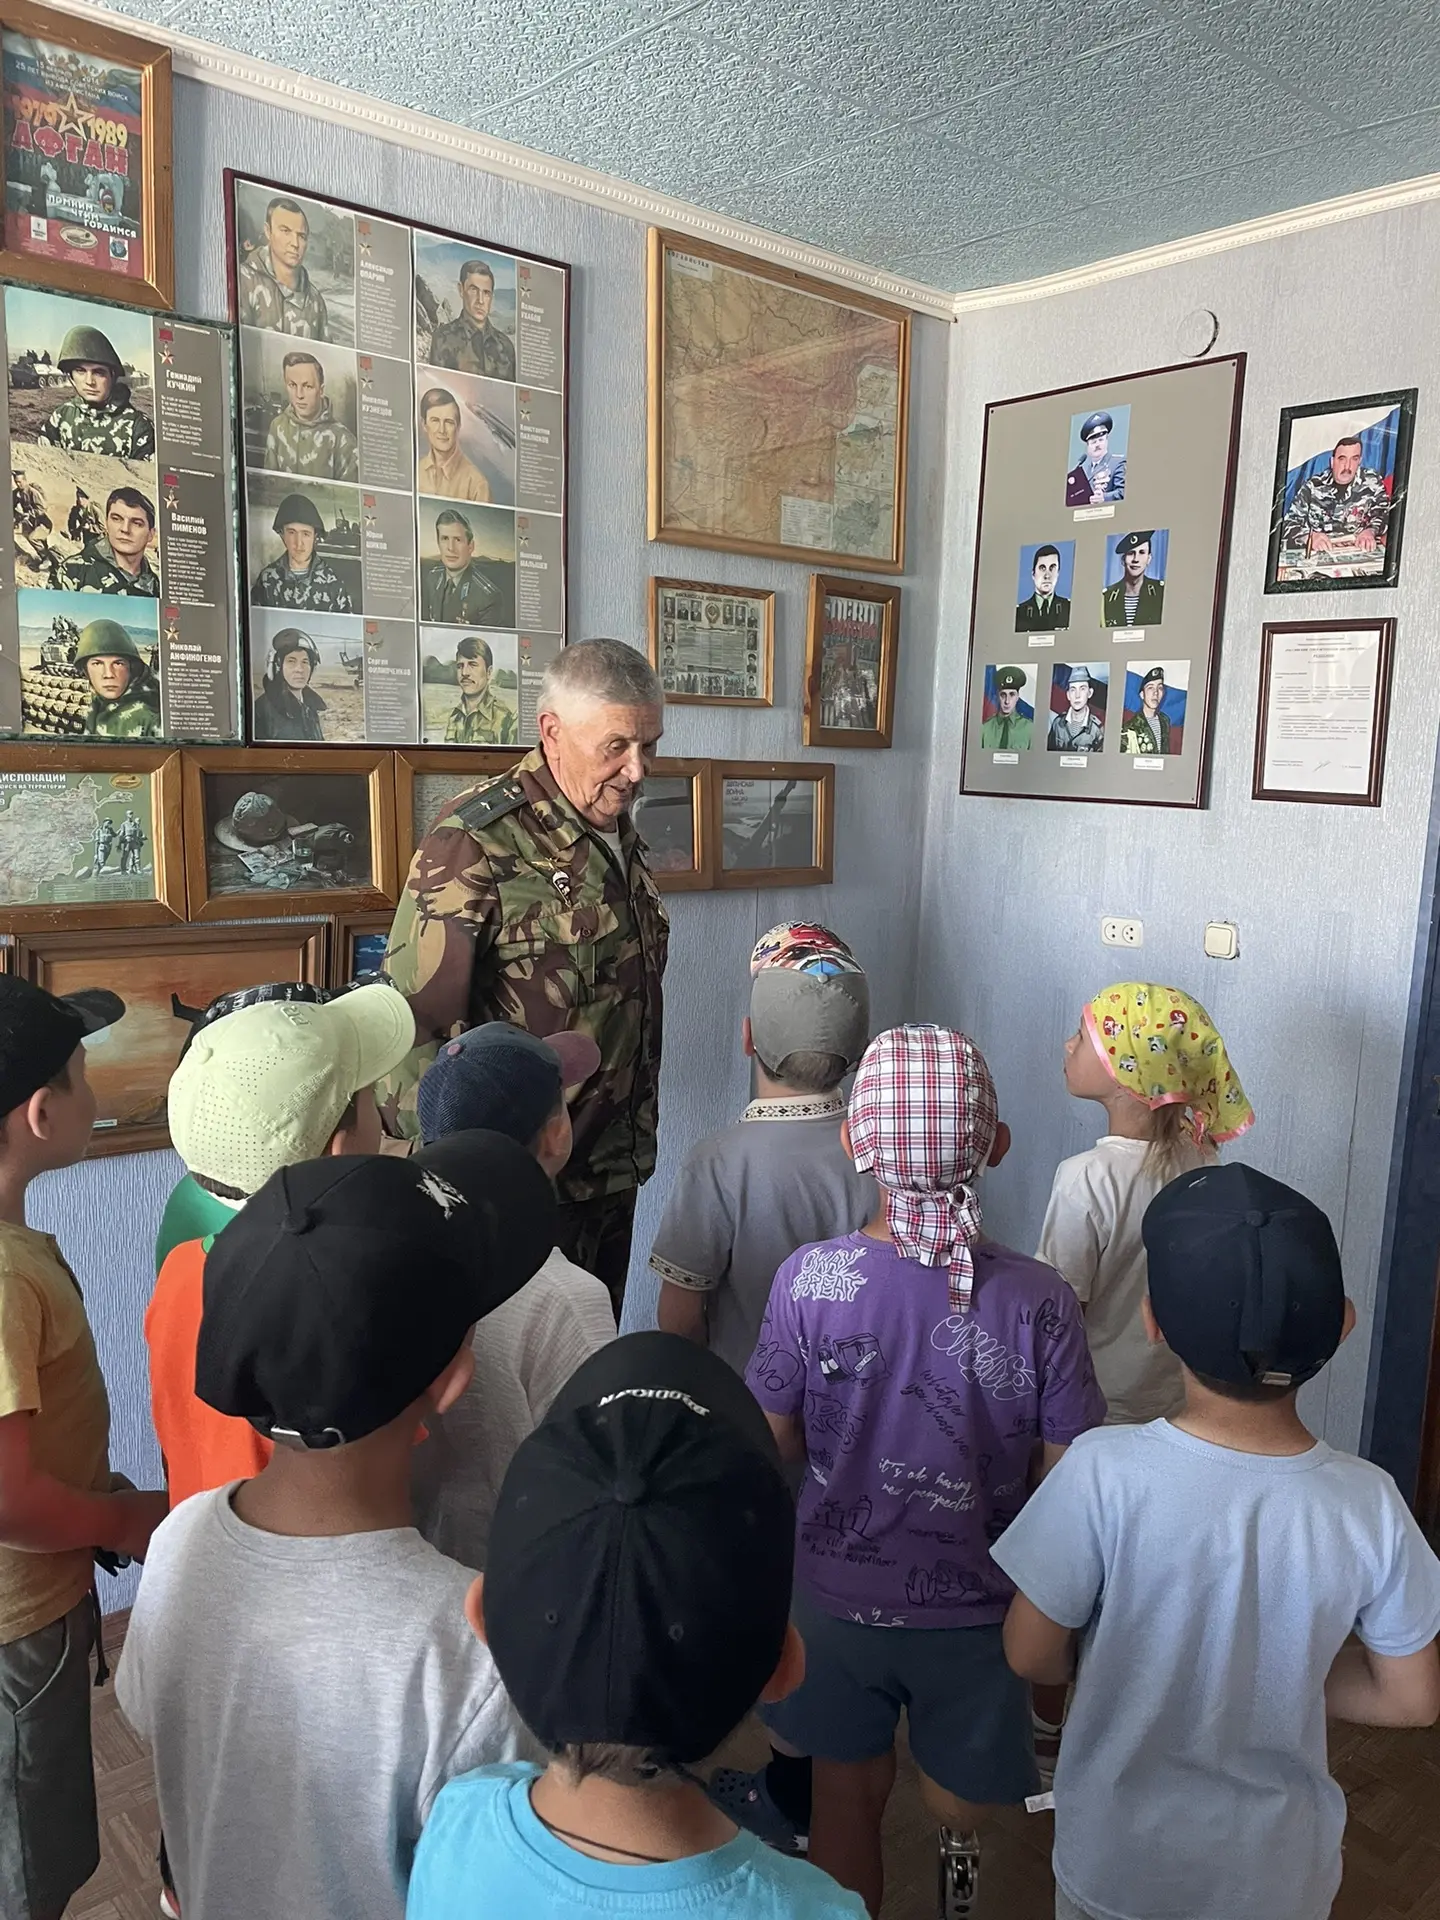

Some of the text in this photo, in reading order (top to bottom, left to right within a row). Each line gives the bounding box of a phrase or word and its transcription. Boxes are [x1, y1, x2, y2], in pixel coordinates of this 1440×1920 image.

[87, 117, 127, 148] 1989
[11, 119, 128, 176] АФГАН
[48, 194, 94, 212] ПОМНИМ
[71, 207, 100, 221] ЧТИМ
[84, 219, 137, 239] ГОРДИМСЯ
[166, 369, 202, 384] Геннадий
[166, 379, 196, 393] КУЧКИН
[171, 512, 205, 525] Василий
[171, 522, 207, 535] ПИМЕНОВ
[169, 642, 202, 652] Николай
[169, 651, 222, 663] АНФИНОГЕНОВ
[0, 773, 66, 783] ИСЛОКАЦИИ
[802, 1246, 868, 1274] OKAY
[790, 1269, 869, 1302] GREAT
